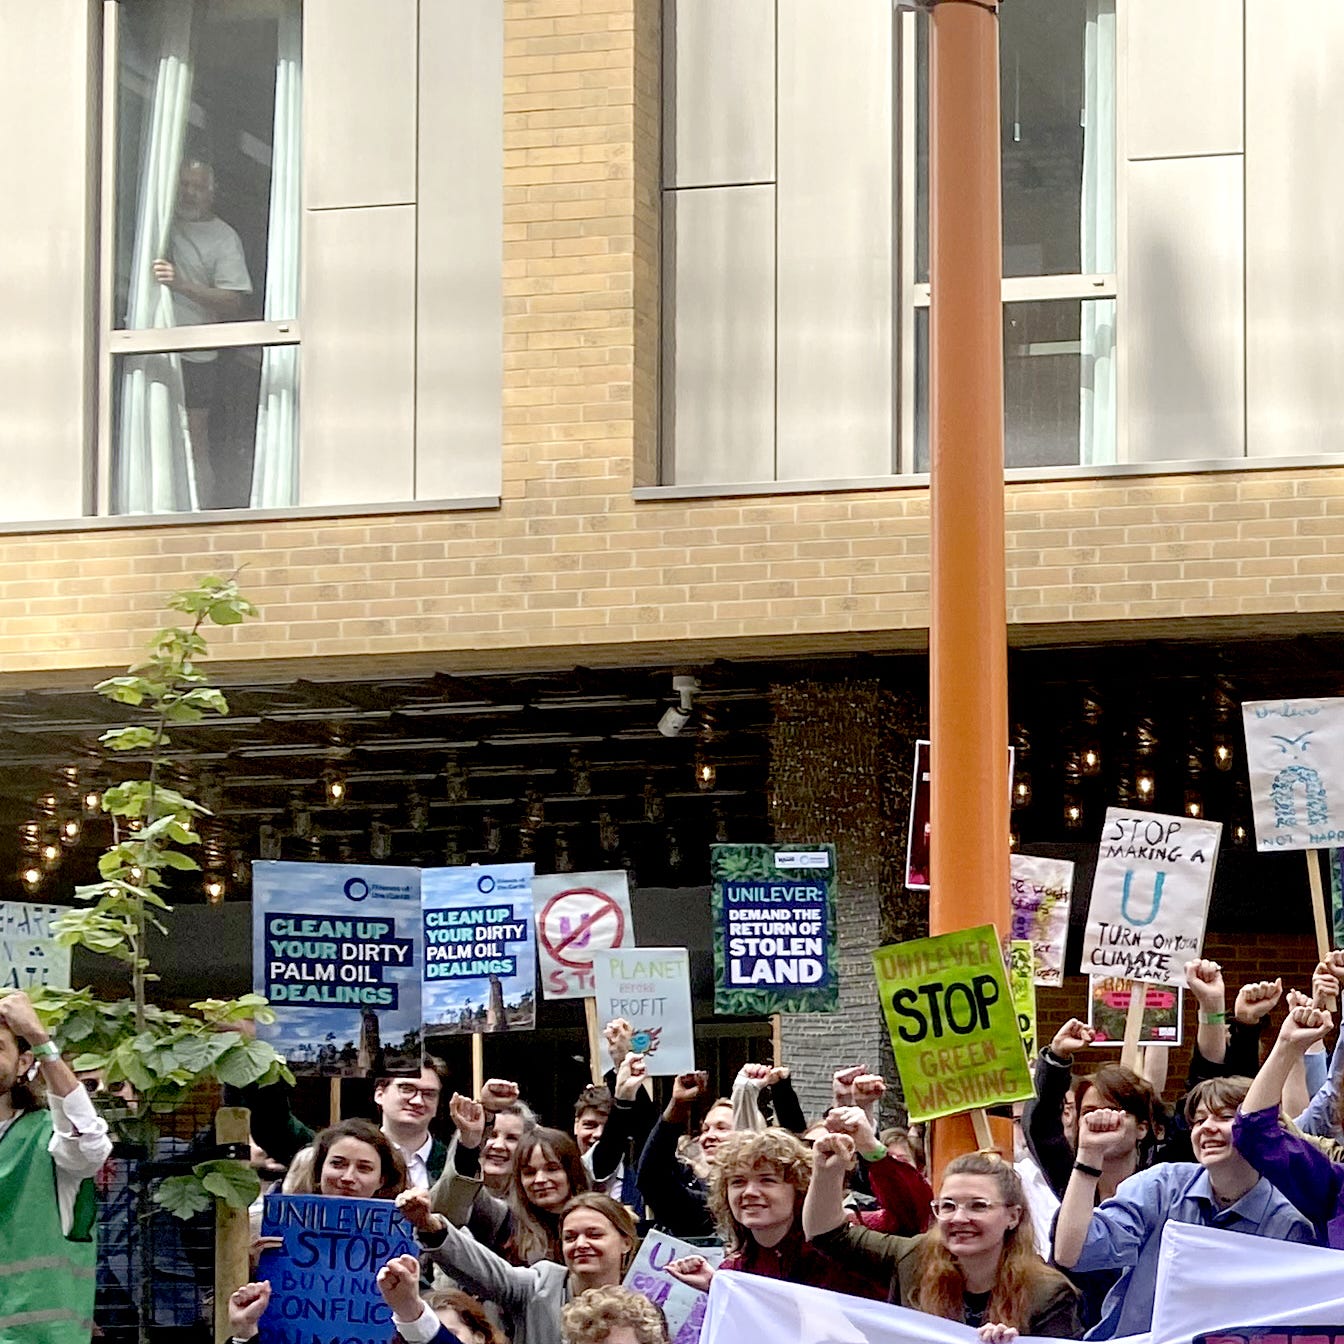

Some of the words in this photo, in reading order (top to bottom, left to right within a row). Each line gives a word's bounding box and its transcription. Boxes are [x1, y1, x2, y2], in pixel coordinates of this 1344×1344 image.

[1110, 818, 1183, 846] STOP
[1262, 834, 1293, 847] NOT
[1105, 845, 1183, 863] MAKING
[1190, 849, 1205, 863] A
[727, 887, 824, 903] UNILEVER:
[1120, 869, 1166, 927] U
[425, 908, 485, 927] CLEAN
[486, 907, 510, 923] UP
[728, 909, 792, 921] DEMAND
[792, 909, 822, 921] THE
[270, 918, 351, 938] CLEAN
[355, 921, 390, 939] UP
[426, 927, 473, 944] YOUR
[474, 923, 525, 942] DIRTY
[729, 922, 798, 936] RETURN
[798, 922, 822, 936] OF
[1098, 922, 1143, 947] TURN
[270, 940, 337, 960] YOUR
[341, 943, 409, 962] DIRTY
[426, 945, 473, 961] PALM
[474, 943, 502, 958] OIL
[729, 937, 823, 957] STOLEN
[426, 958, 514, 978] DEALINGS
[609, 958, 684, 980] PLANET
[880, 939, 993, 981] UNILEVER
[1090, 947, 1172, 971] CLIMATE
[270, 962, 335, 981] PALM
[340, 965, 378, 983] OIL
[730, 958, 824, 984] LAND
[1124, 966, 1171, 983] PLANS
[550, 970, 596, 996] ST
[618, 982, 656, 994] BEFORE
[270, 984, 393, 1005] DEALINGS
[610, 996, 668, 1017] PROFIT
[892, 974, 999, 1043] STOP
[911, 1068, 1018, 1111] WASHING
[291, 1231, 391, 1273] STOP
